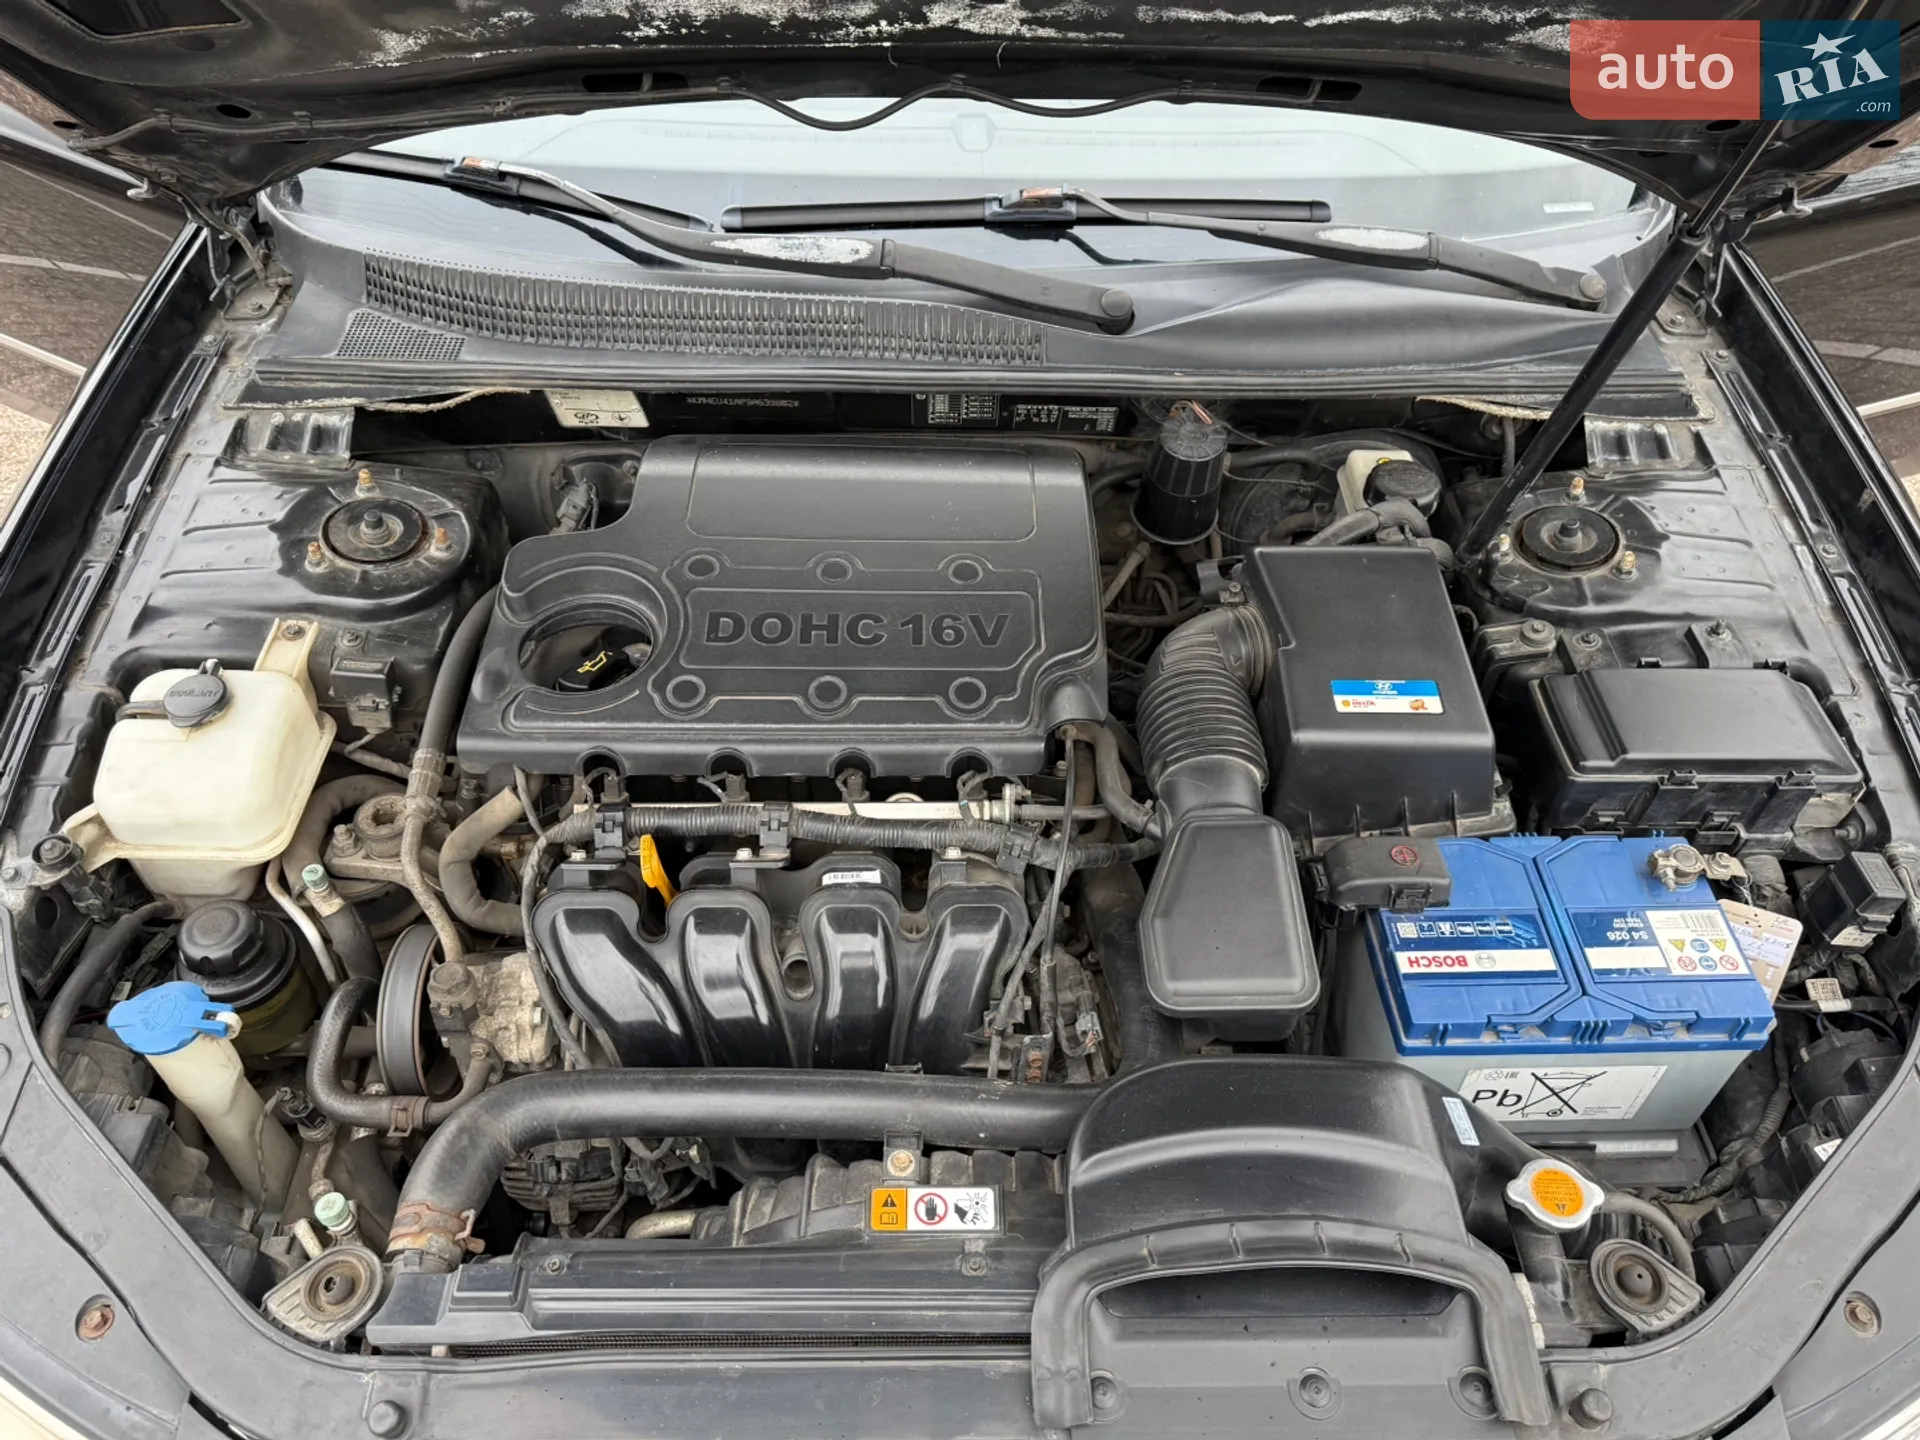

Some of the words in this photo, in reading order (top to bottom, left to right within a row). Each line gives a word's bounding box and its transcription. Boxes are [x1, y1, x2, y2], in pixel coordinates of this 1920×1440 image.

[705, 611, 888, 647] DOHC
[899, 612, 1011, 648] 16V
[1631, 930, 1649, 940] S4
[1407, 955, 1469, 968] BOSCH
[1471, 1088, 1523, 1107] Pb
